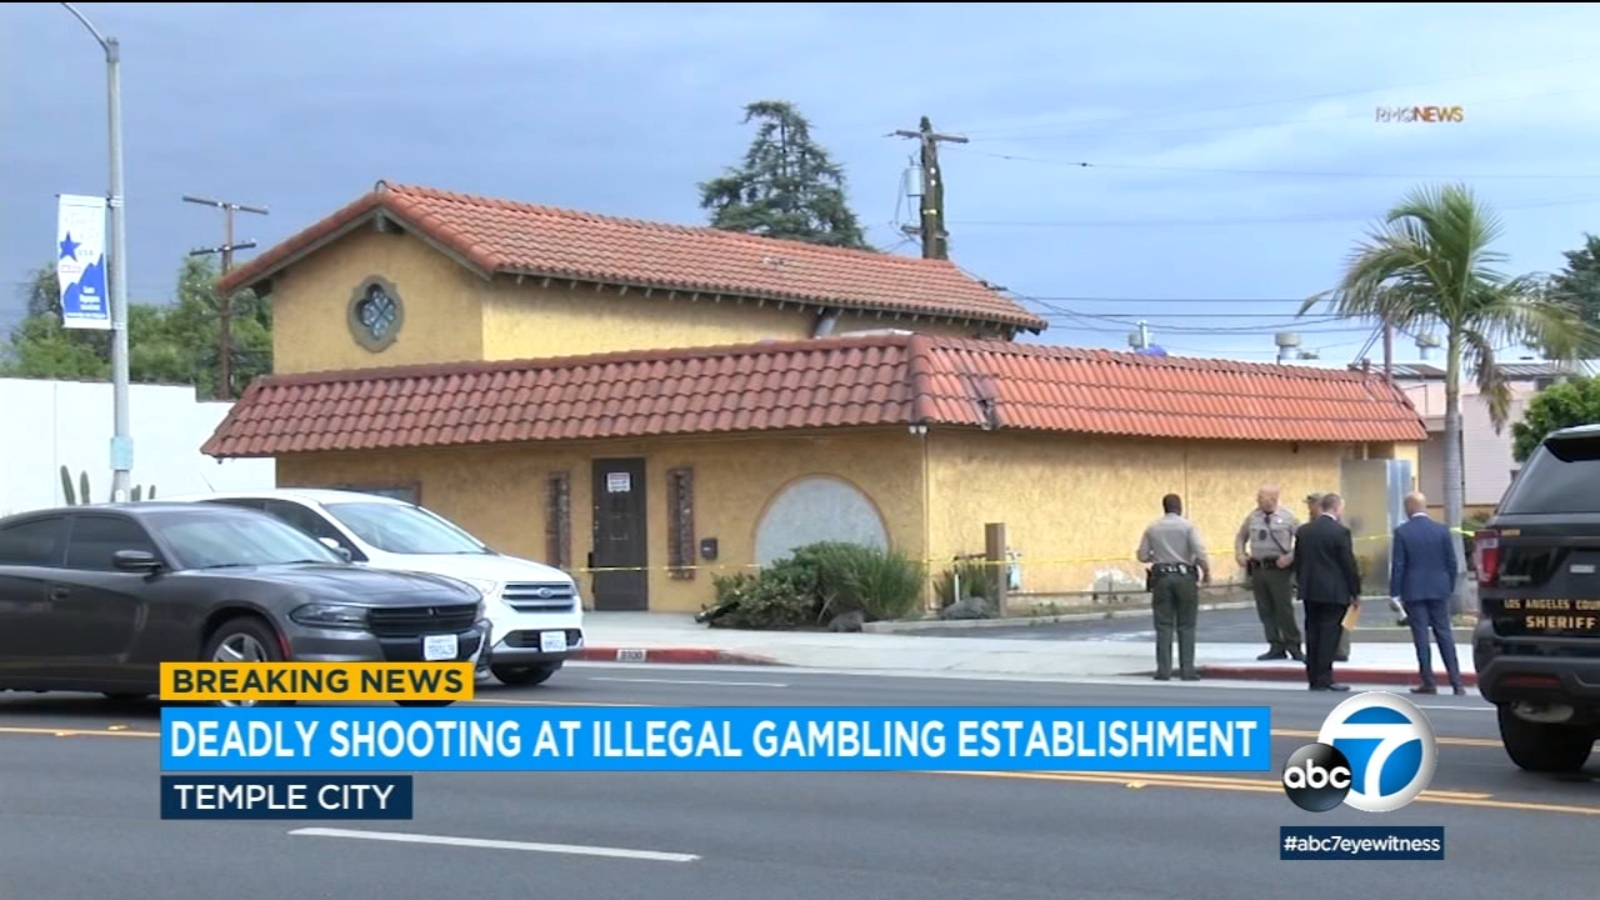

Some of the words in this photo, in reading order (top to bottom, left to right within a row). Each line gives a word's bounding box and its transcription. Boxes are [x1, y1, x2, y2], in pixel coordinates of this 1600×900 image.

[1505, 599, 1520, 609] LOS
[1525, 599, 1570, 610] ANGELES
[1526, 616, 1596, 629] SHERIFF
